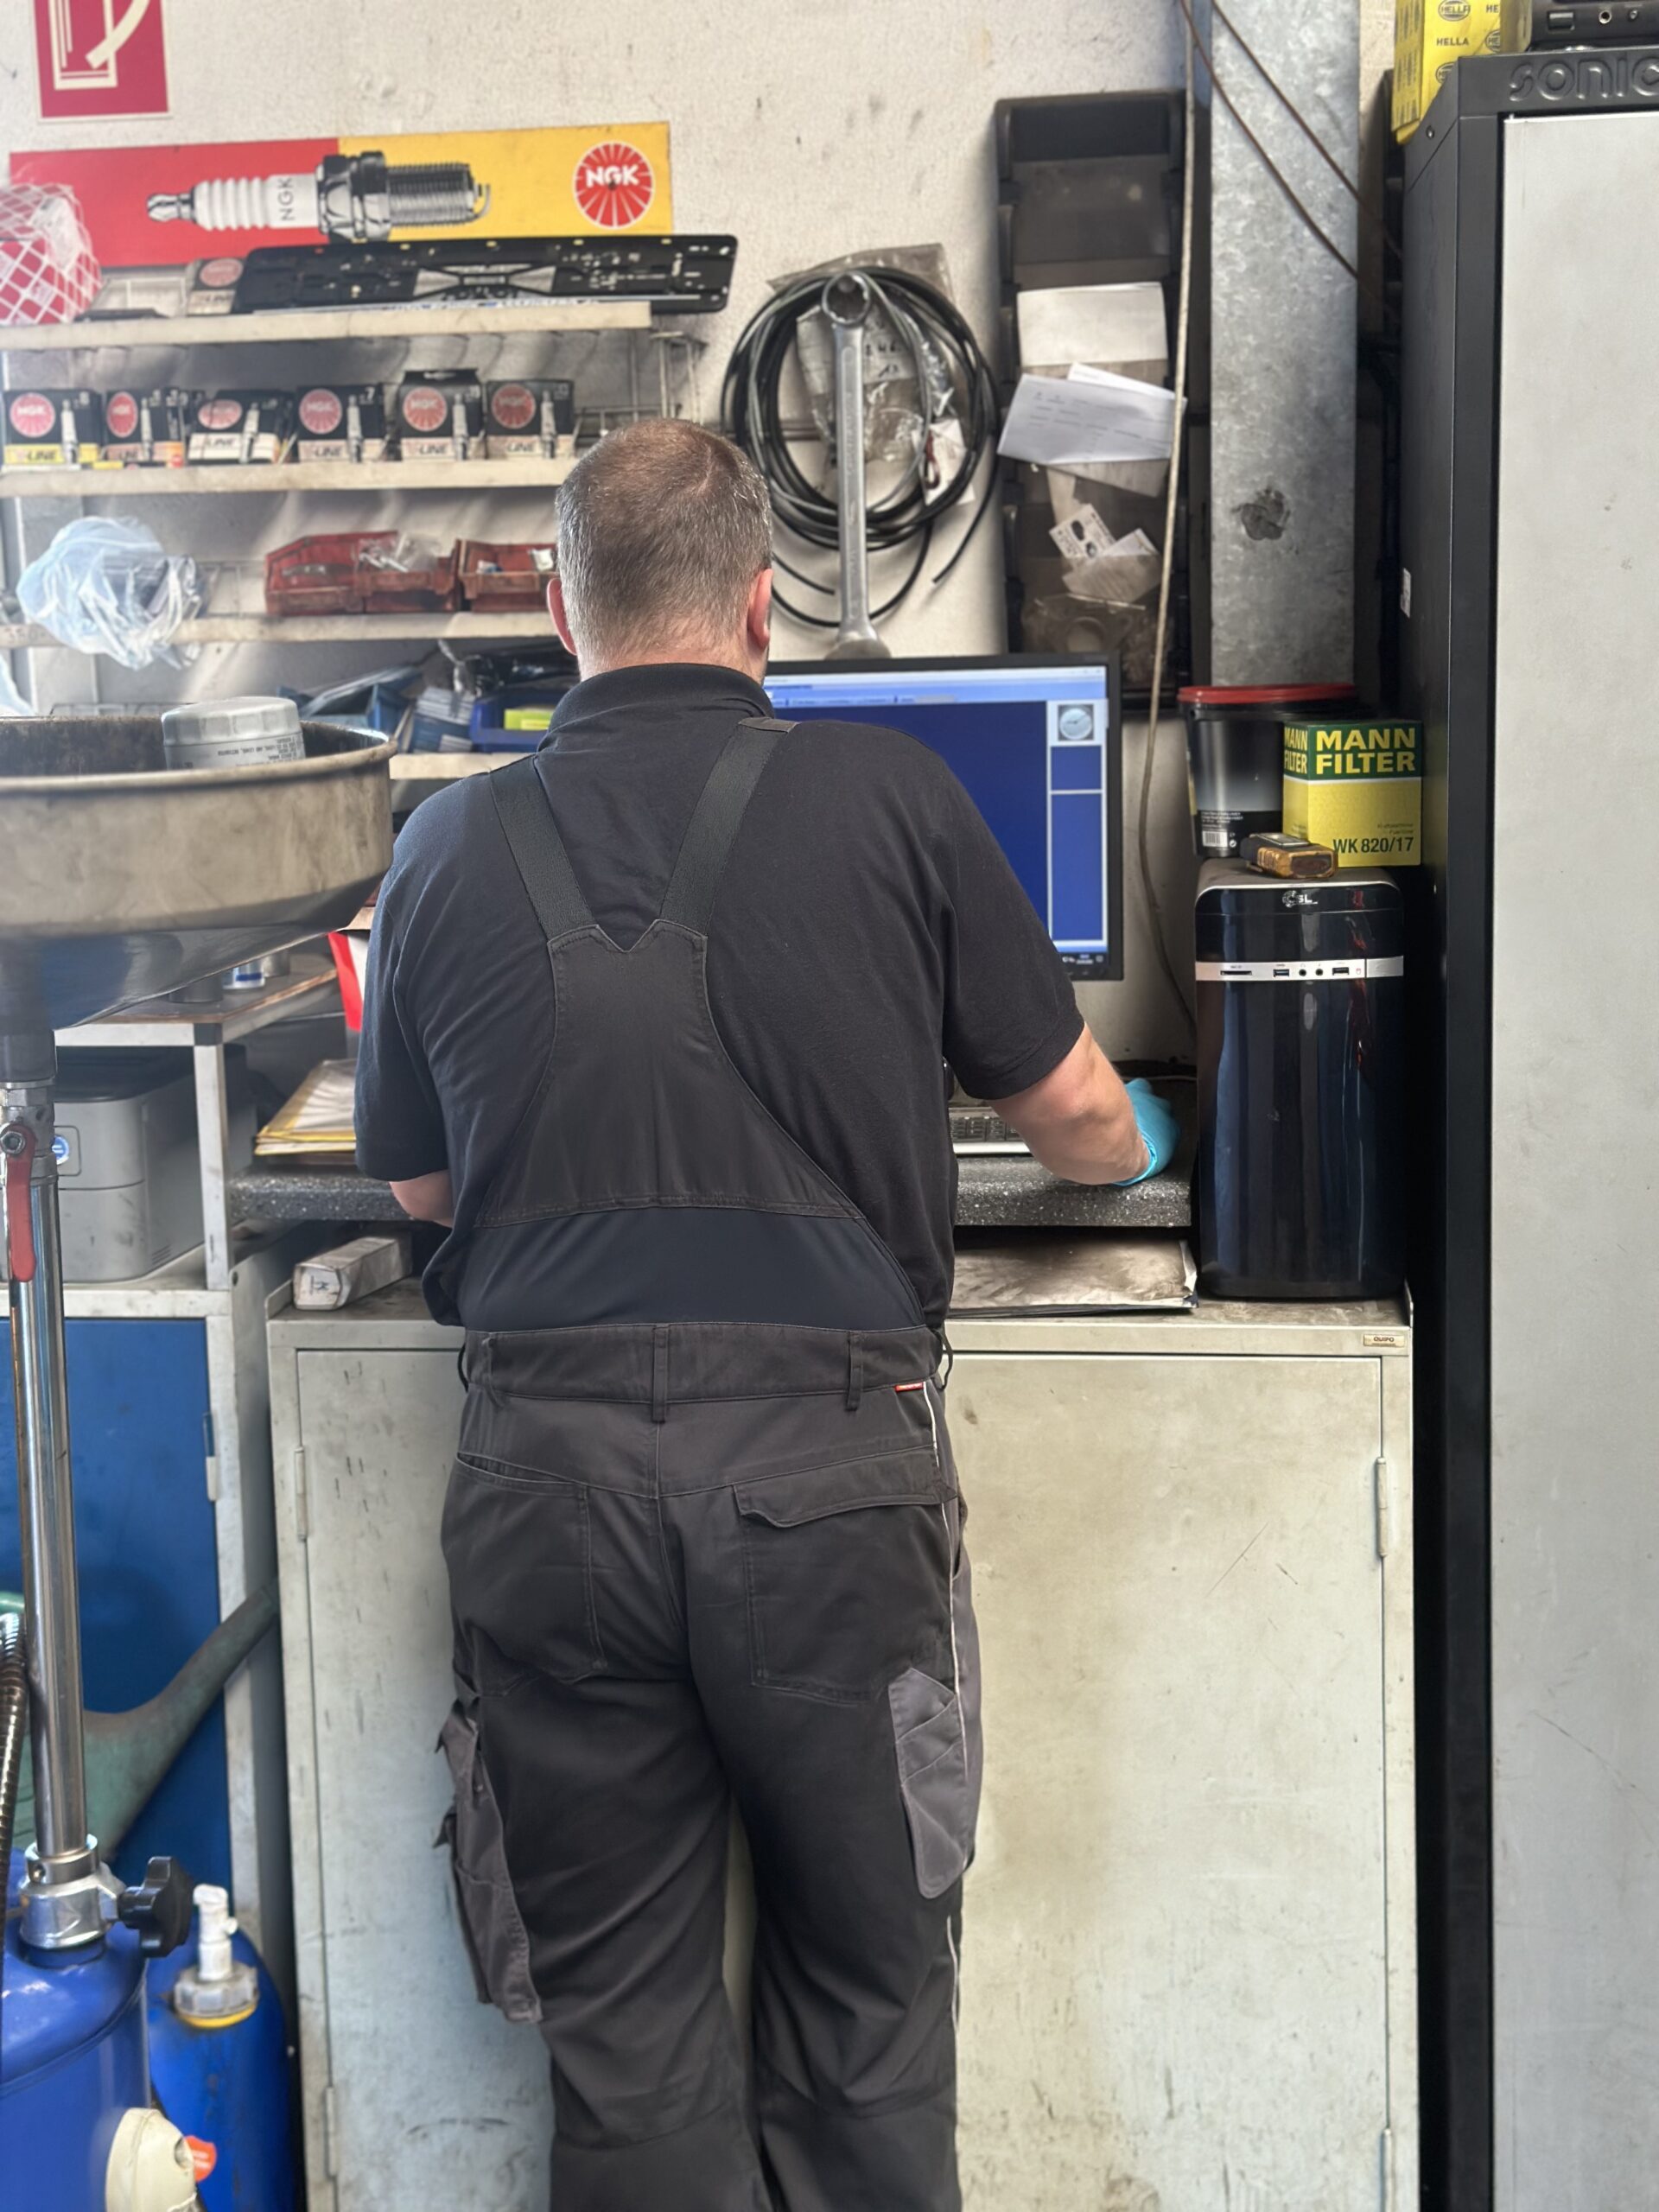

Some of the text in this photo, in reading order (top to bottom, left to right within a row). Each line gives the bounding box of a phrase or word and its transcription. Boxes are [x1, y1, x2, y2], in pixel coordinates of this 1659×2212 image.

[1437, 37, 1469, 46] HELLA
[586, 164, 639, 188] NGK
[277, 177, 295, 220] NGK
[1284, 726, 1307, 751] MANN
[1316, 728, 1415, 751] MANN
[1284, 749, 1307, 774] FILTER
[1316, 751, 1415, 774] FILTER
[1333, 837, 1414, 853] WK 820/17
